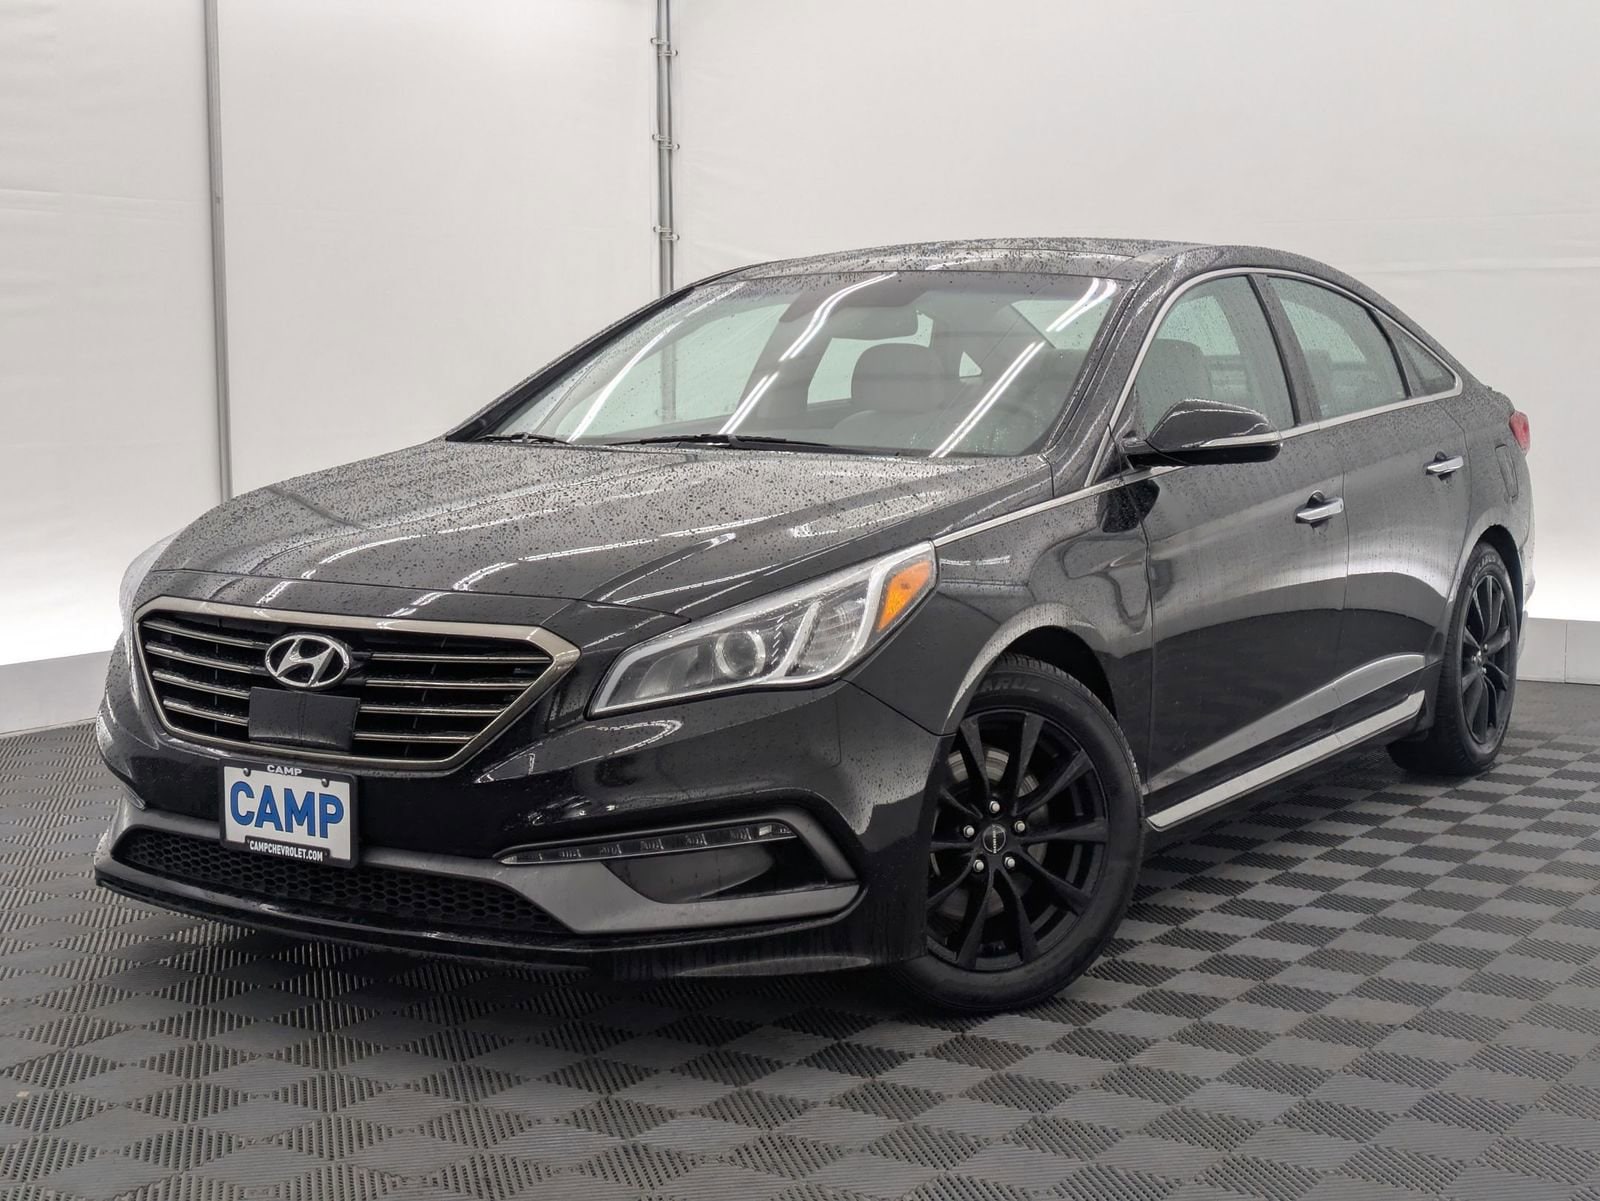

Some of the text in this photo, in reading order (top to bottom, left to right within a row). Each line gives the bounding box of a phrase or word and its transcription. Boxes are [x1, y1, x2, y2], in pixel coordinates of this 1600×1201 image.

[266, 764, 303, 776] CAMP
[230, 780, 345, 839] CAMP
[249, 840, 323, 862] CAMPCHEVROLET.COM
